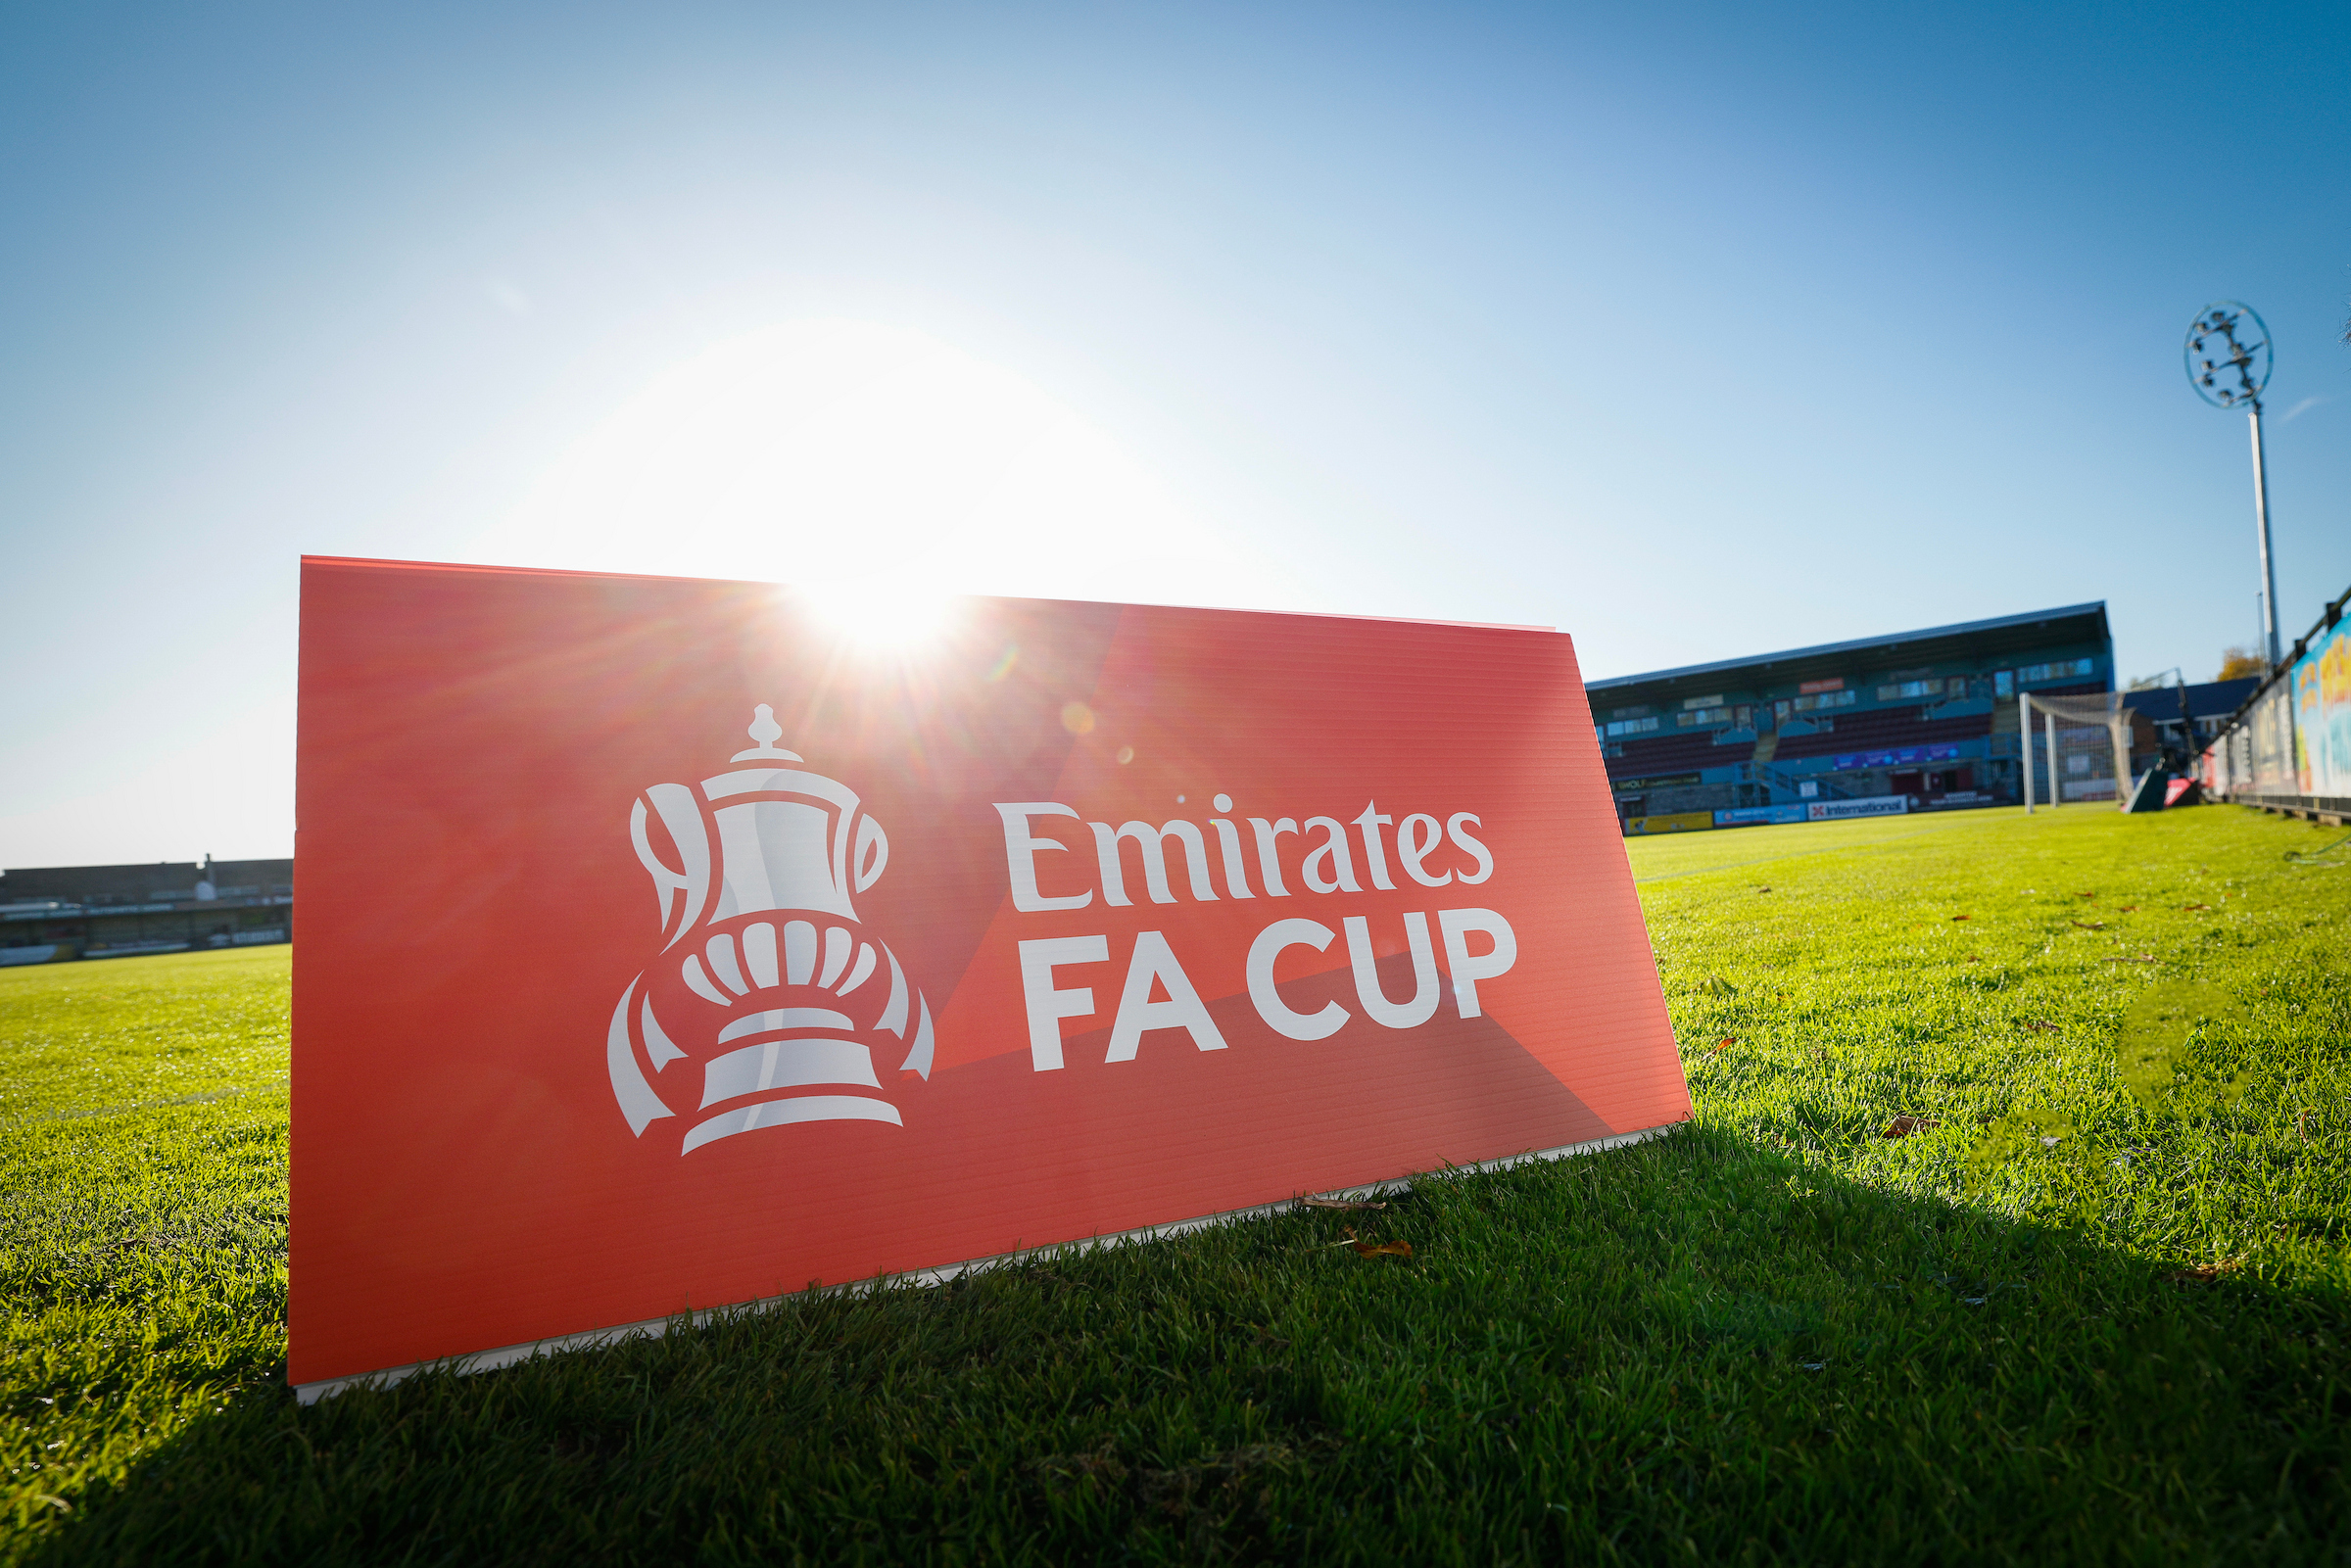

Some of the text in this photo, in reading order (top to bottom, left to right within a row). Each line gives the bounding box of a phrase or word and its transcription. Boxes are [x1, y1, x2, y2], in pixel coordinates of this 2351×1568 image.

[991, 793, 1494, 912] Emirates
[1826, 799, 1901, 816] International
[1018, 908, 1517, 1071] FA CUP
